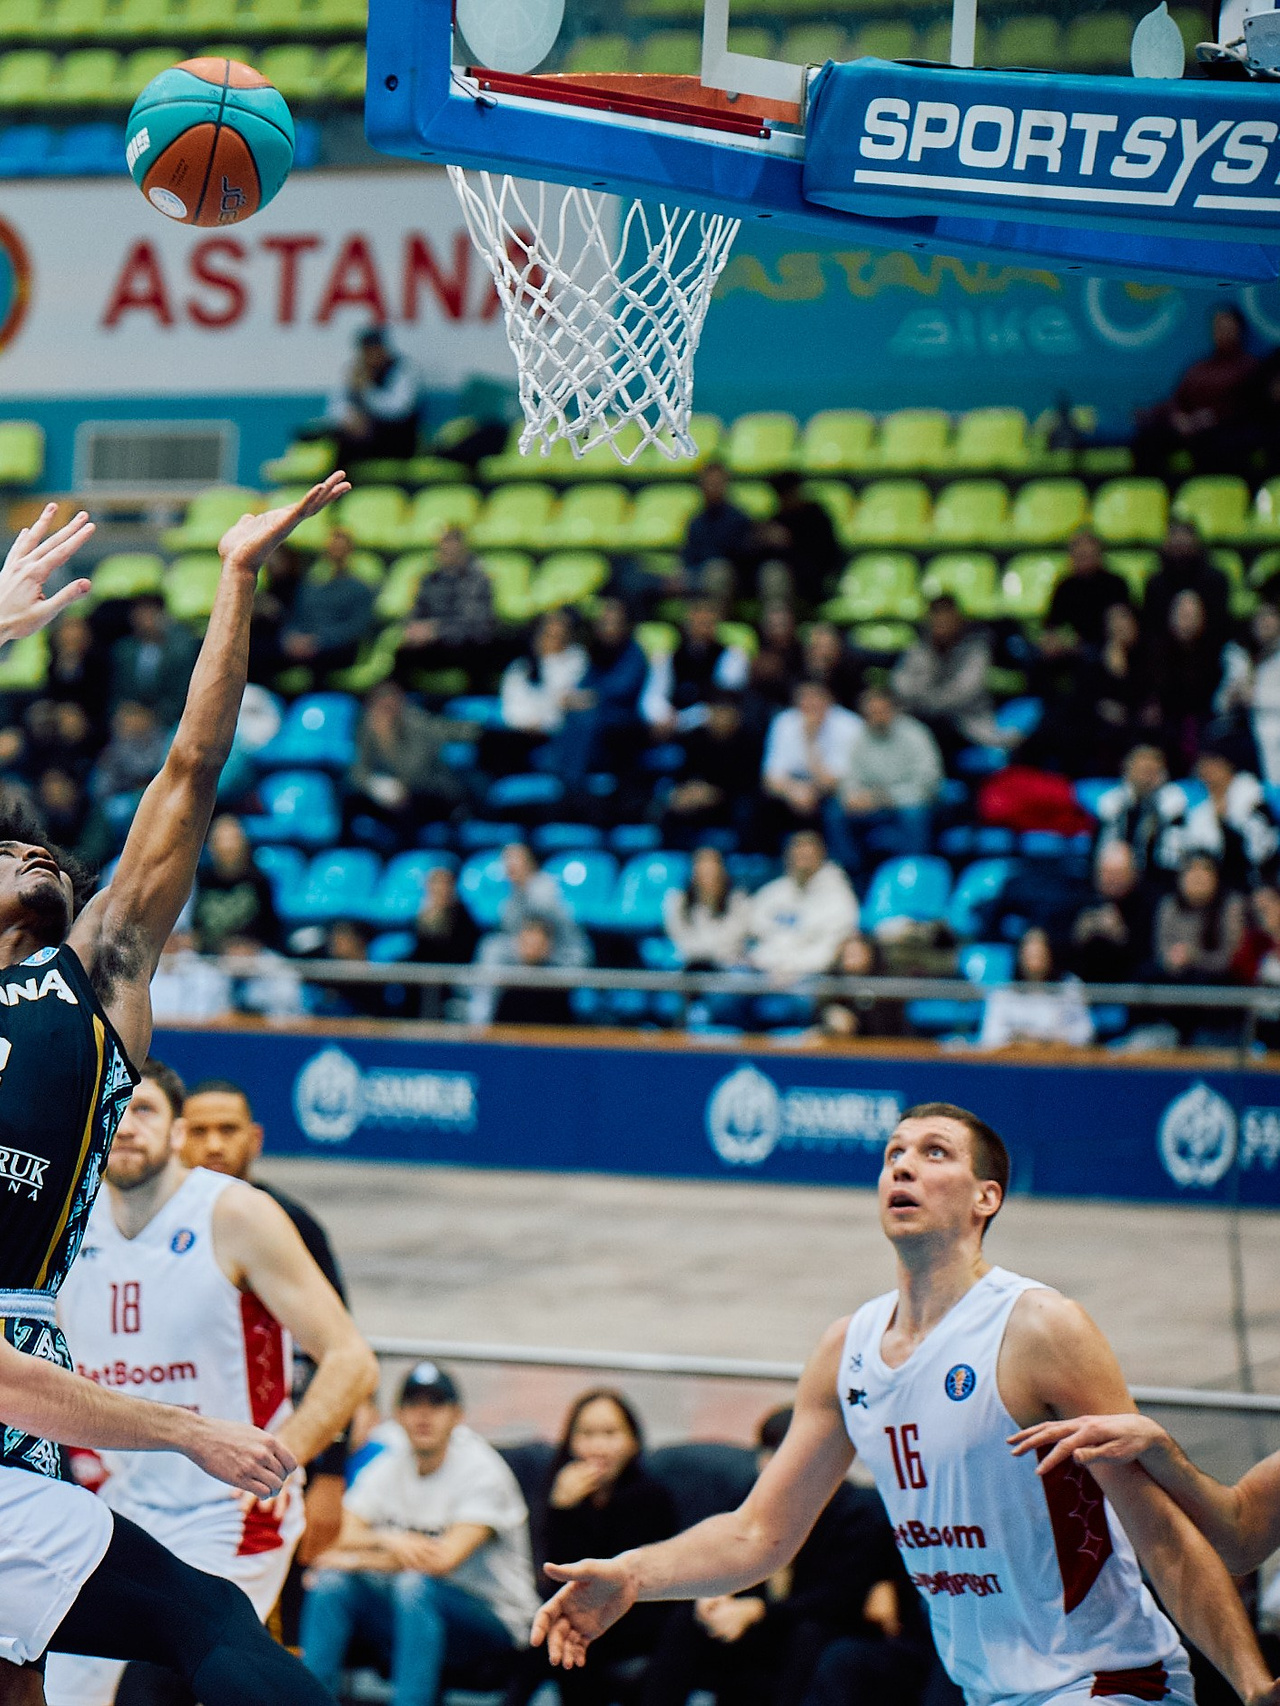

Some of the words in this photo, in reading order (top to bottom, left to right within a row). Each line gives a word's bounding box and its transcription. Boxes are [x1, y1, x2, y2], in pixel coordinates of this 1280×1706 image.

[858, 97, 1280, 206] SPORTSYS
[102, 232, 563, 330] ASTANA
[108, 1281, 142, 1334] 18
[884, 1422, 928, 1490] 16
